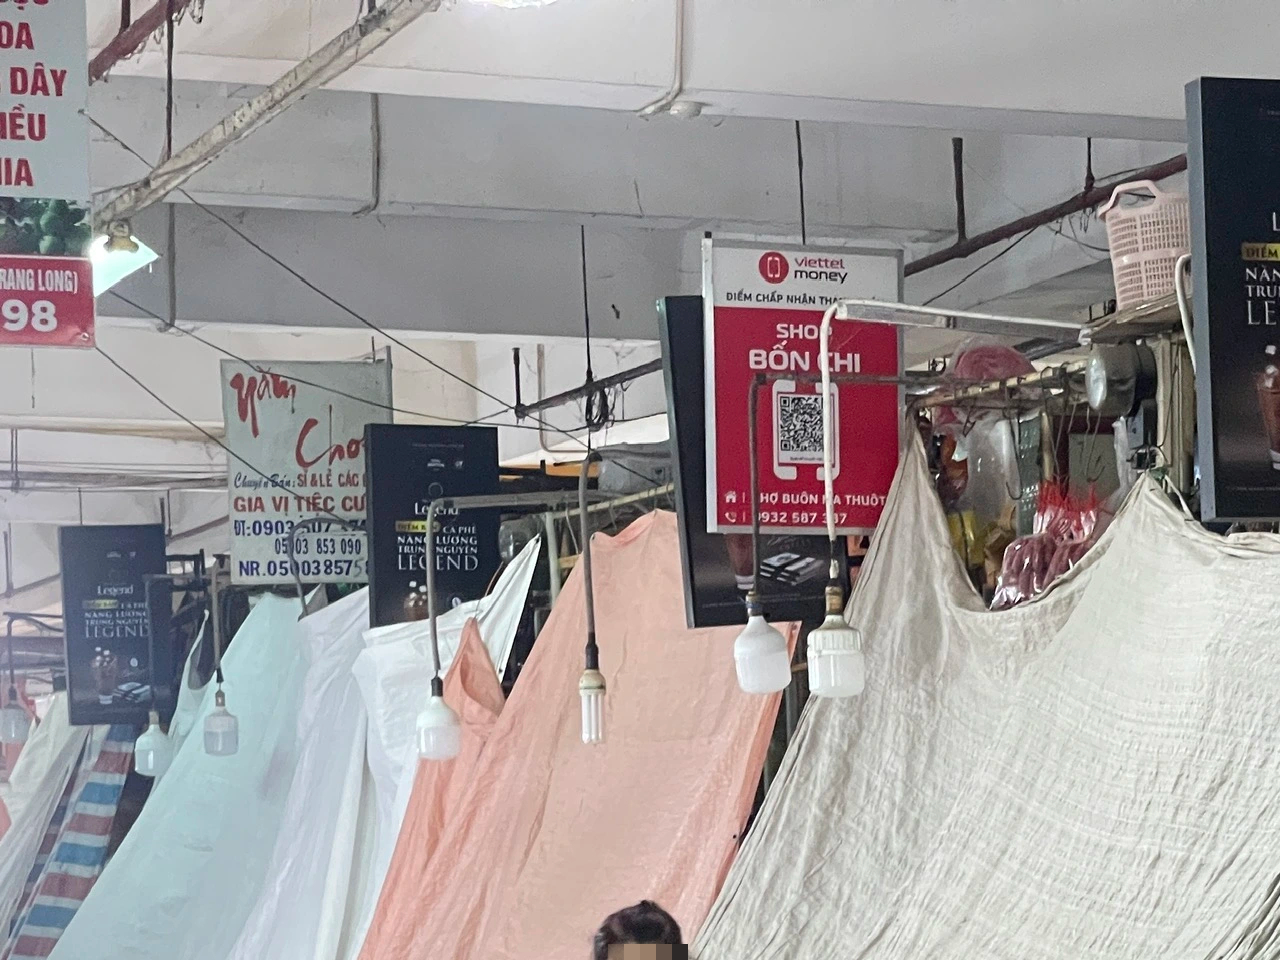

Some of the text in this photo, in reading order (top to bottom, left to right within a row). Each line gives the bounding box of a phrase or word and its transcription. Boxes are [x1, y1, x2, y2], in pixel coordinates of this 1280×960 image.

[10, 62, 67, 96] DÂY
[0, 157, 34, 187] IA
[794, 256, 845, 270] viettel
[38, 269, 79, 294] LONG)
[794, 270, 848, 284] money
[726, 288, 846, 306] ĐIỂM CHẤP NHẬN THA
[2, 299, 57, 332] 98
[749, 340, 810, 371] BỐN
[338, 470, 359, 488] CÁC
[234, 491, 366, 517] GIA VỊ TIỆC CƯ
[760, 492, 779, 505] HỢ
[782, 491, 818, 504] BUÔN
[414, 502, 460, 518] Leend
[758, 511, 788, 523] 932
[792, 512, 817, 524] 587
[316, 538, 336, 556] 853
[341, 538, 361, 555] 090
[399, 546, 425, 554] TRUN
